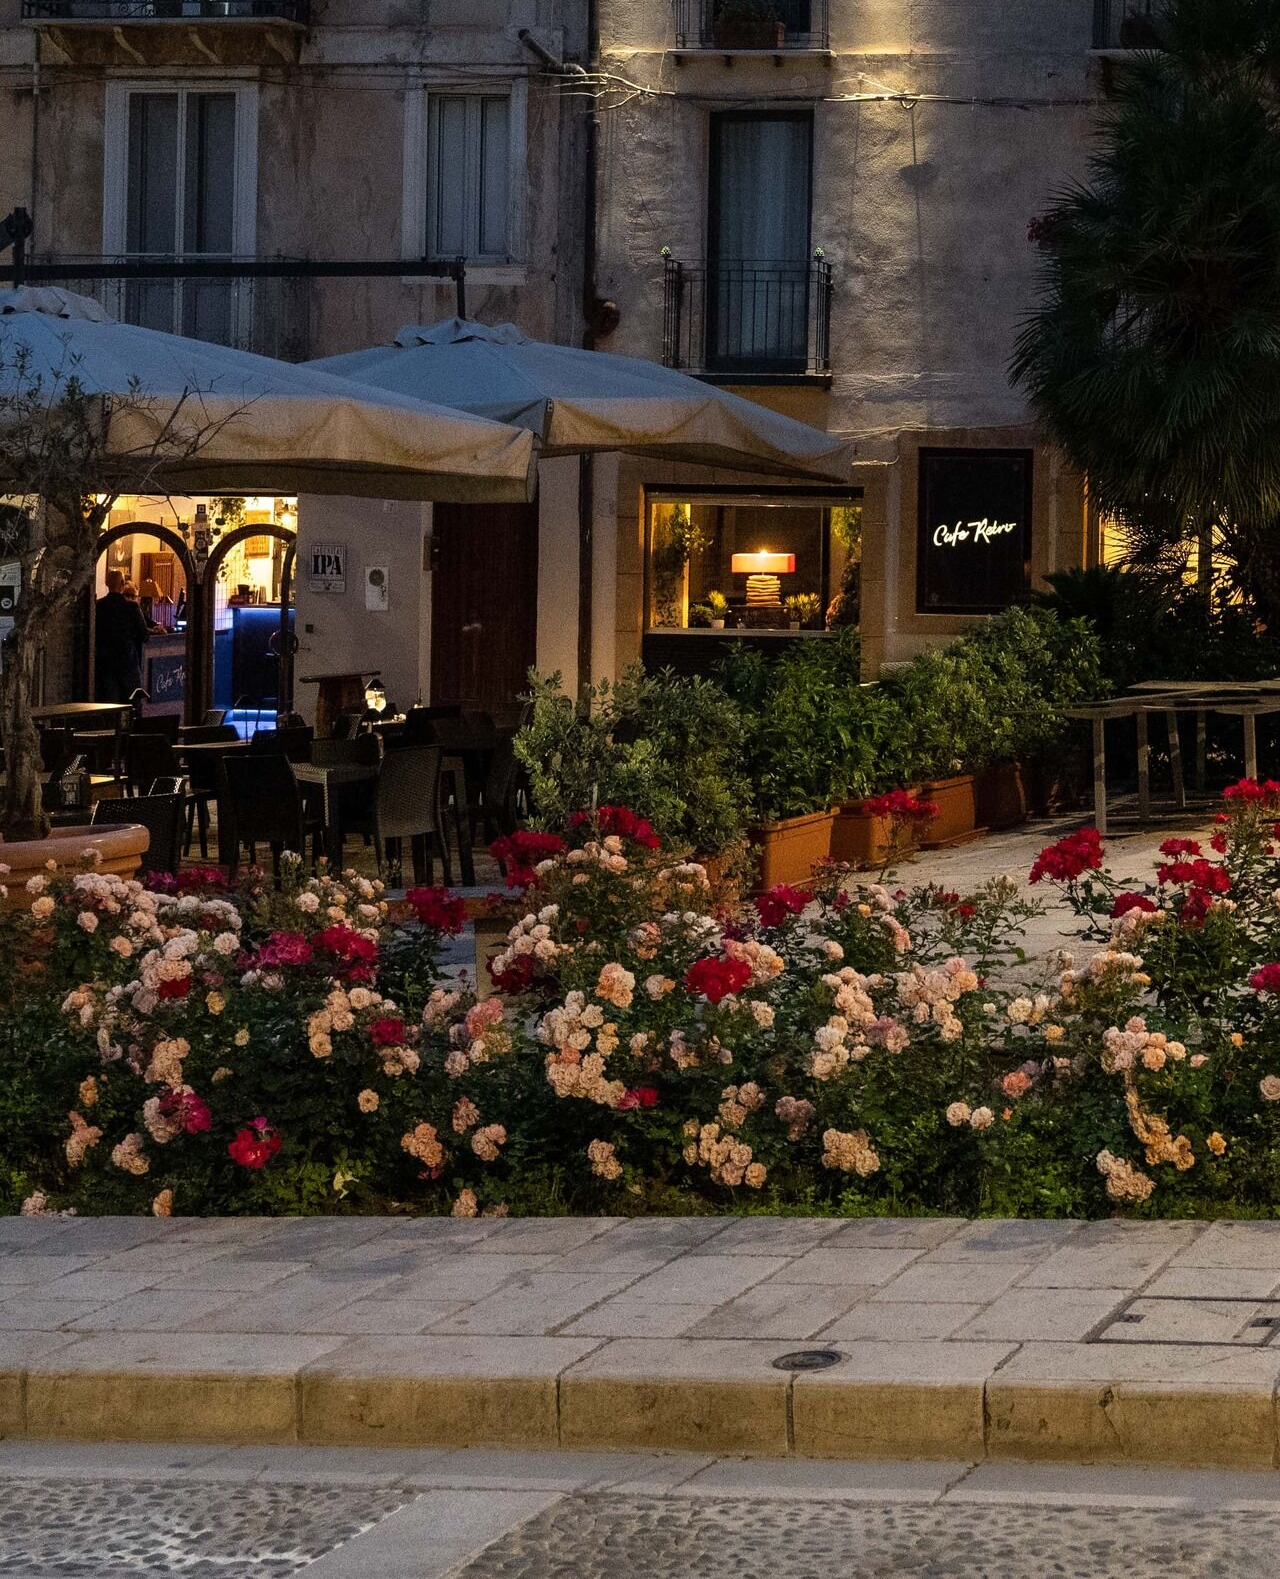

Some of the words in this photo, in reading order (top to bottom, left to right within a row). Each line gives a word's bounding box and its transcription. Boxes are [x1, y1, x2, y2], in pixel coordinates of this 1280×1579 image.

[933, 520, 970, 547] Cafe
[967, 517, 1017, 544] Retro
[312, 554, 342, 575] IPA
